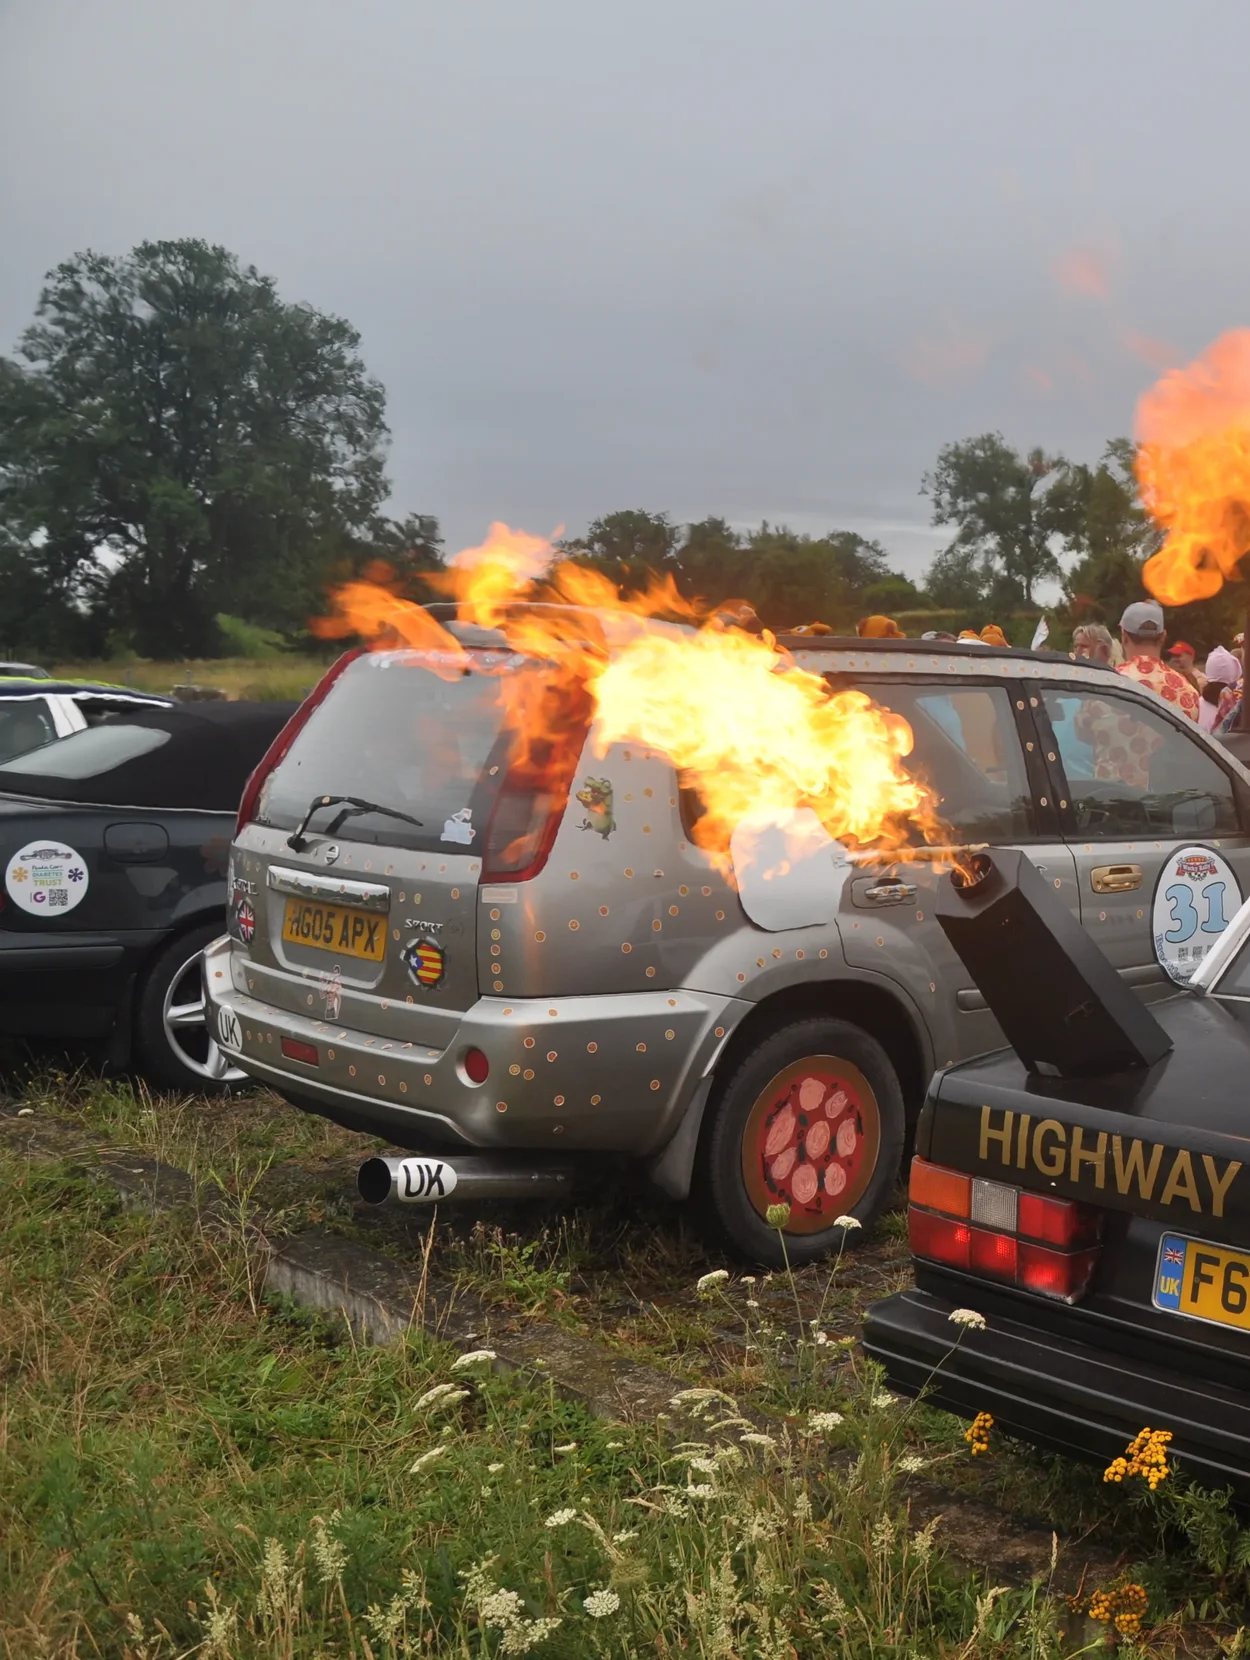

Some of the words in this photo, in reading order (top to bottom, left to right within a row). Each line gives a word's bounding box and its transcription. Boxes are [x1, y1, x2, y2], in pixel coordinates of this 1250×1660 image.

[34, 879, 63, 887] TRUST
[404, 918, 444, 934] SPORT
[1165, 881, 1229, 944] 31
[338, 914, 380, 953] APX
[217, 1009, 240, 1047] UK
[979, 1105, 1242, 1217] HIGHWAY
[402, 1164, 445, 1197] UK
[1160, 1275, 1180, 1297] UK
